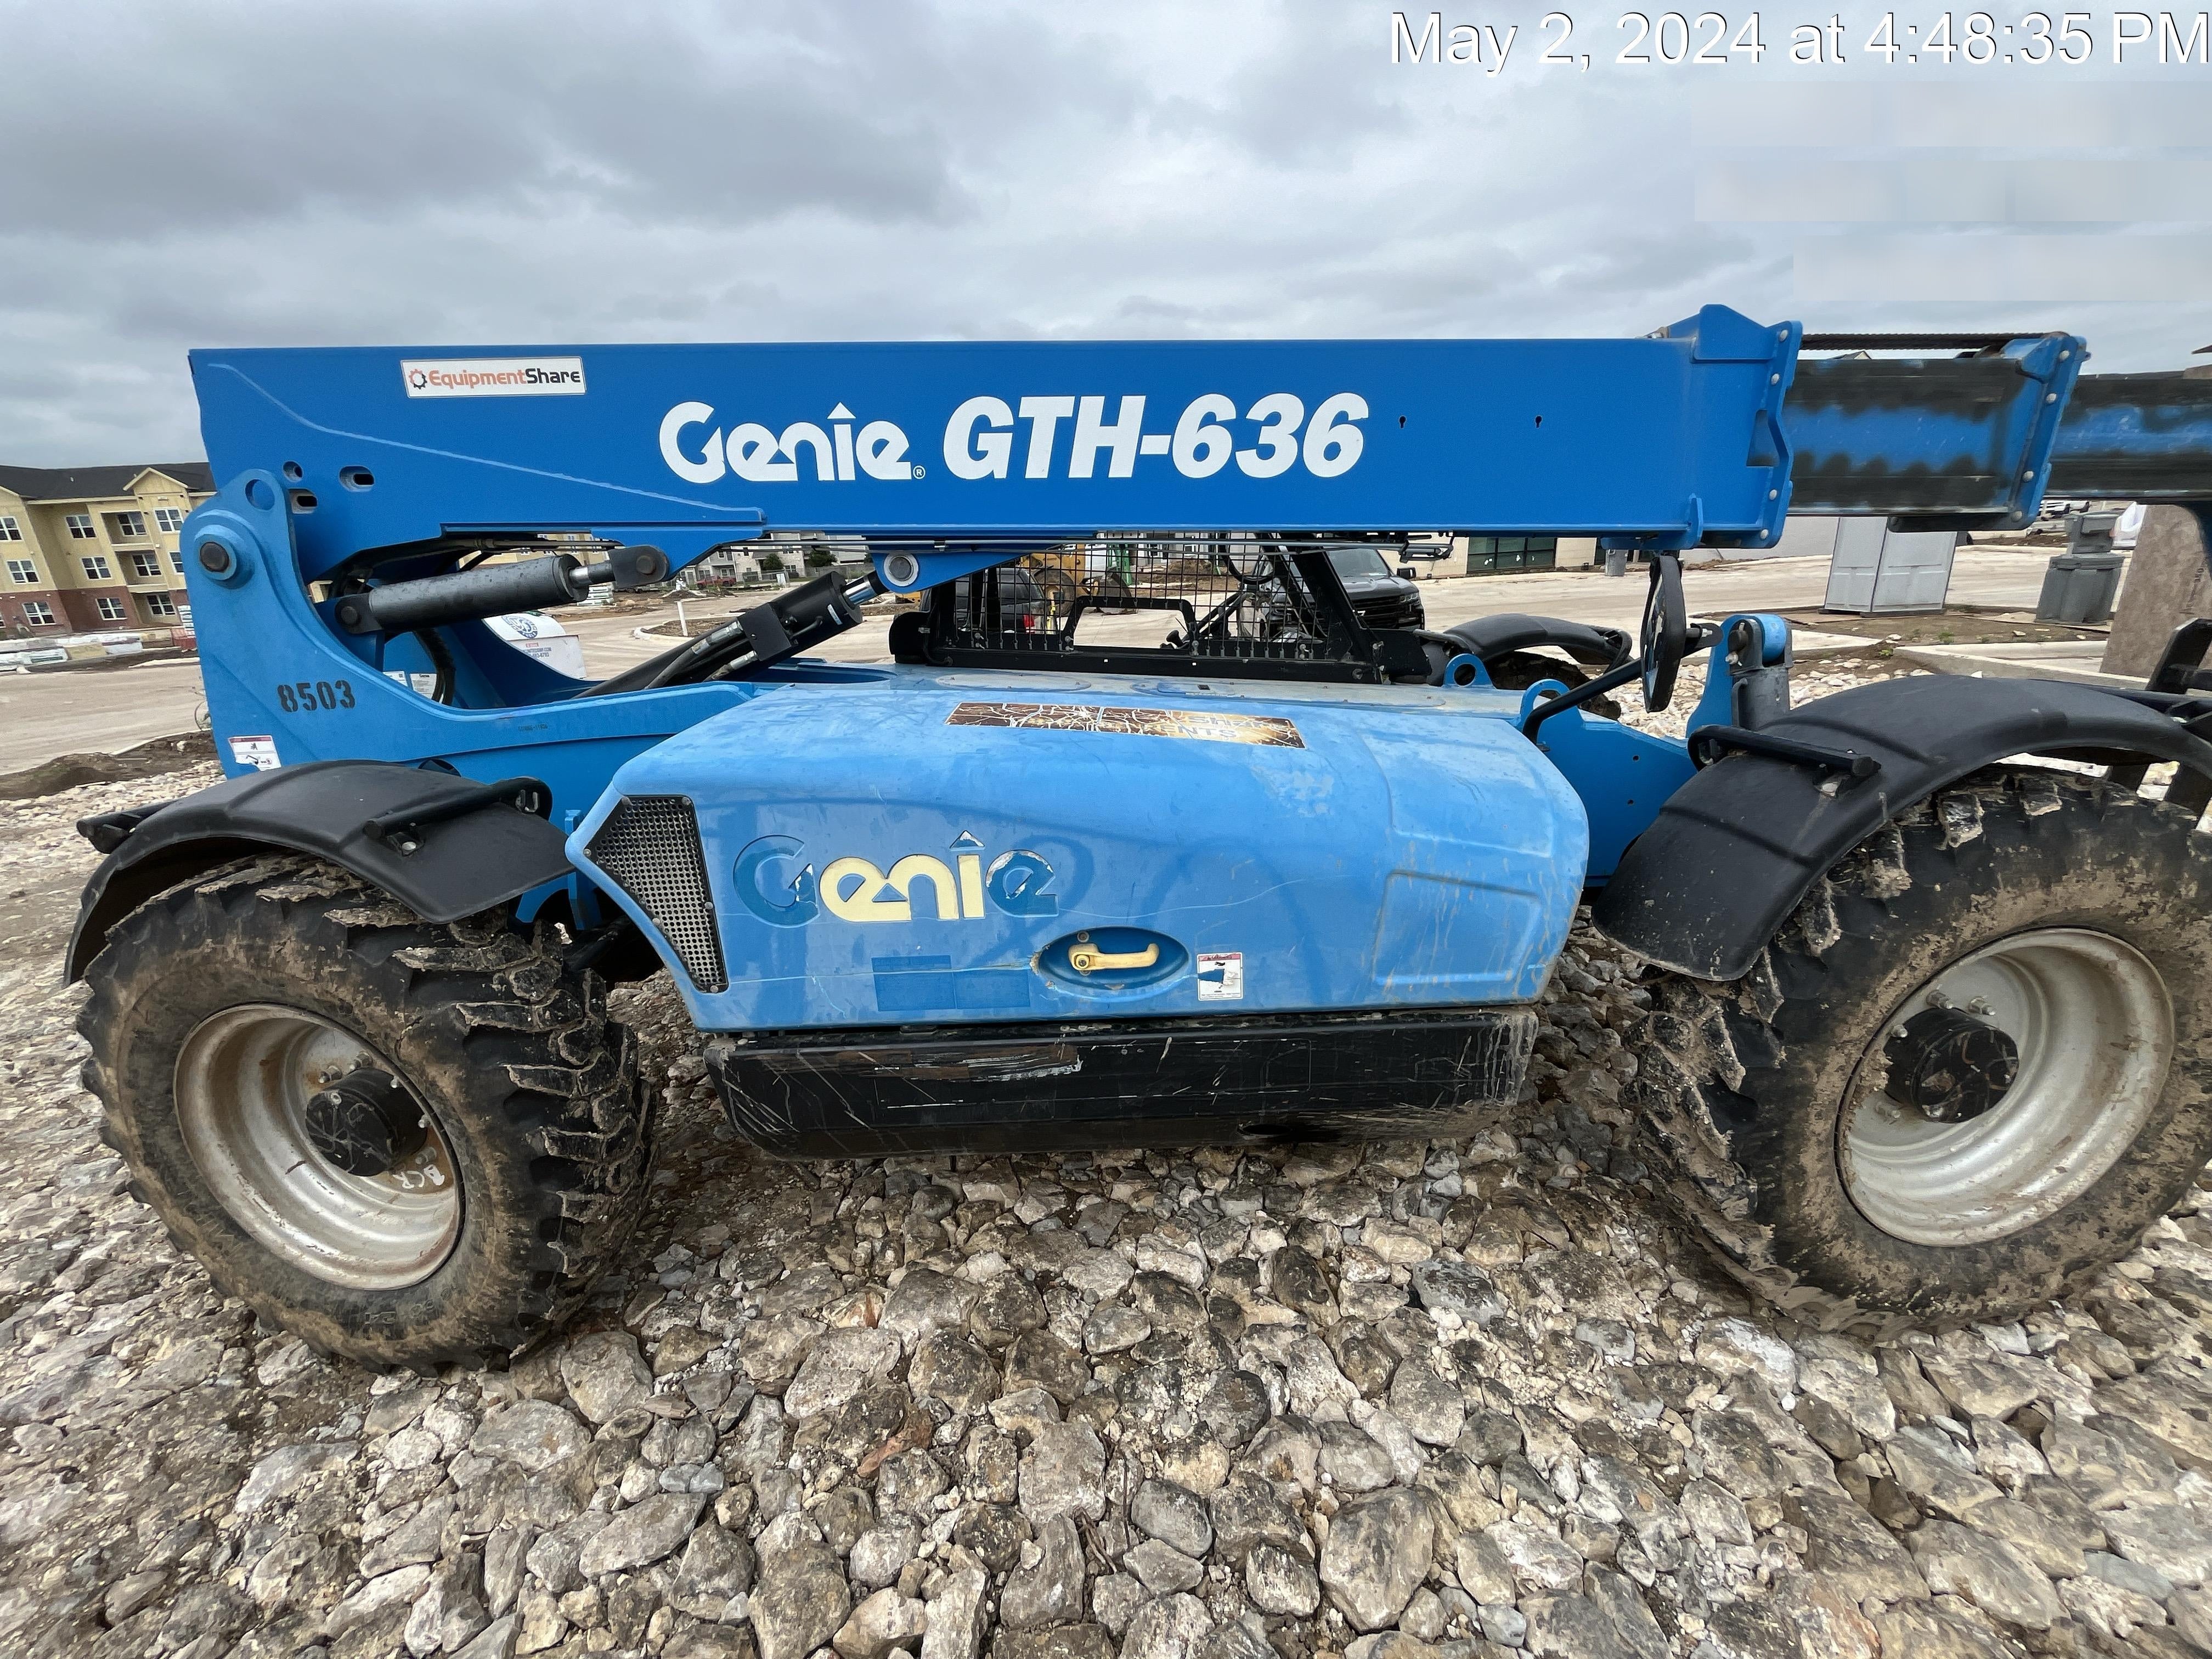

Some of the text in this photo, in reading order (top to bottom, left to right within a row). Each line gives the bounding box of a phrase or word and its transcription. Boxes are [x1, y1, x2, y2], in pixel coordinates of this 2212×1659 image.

[428, 368, 580, 389] EquipmentShare
[943, 392, 1369, 479] GTH-636
[277, 680, 356, 713] 8503
[733, 830, 1059, 928] Genie
